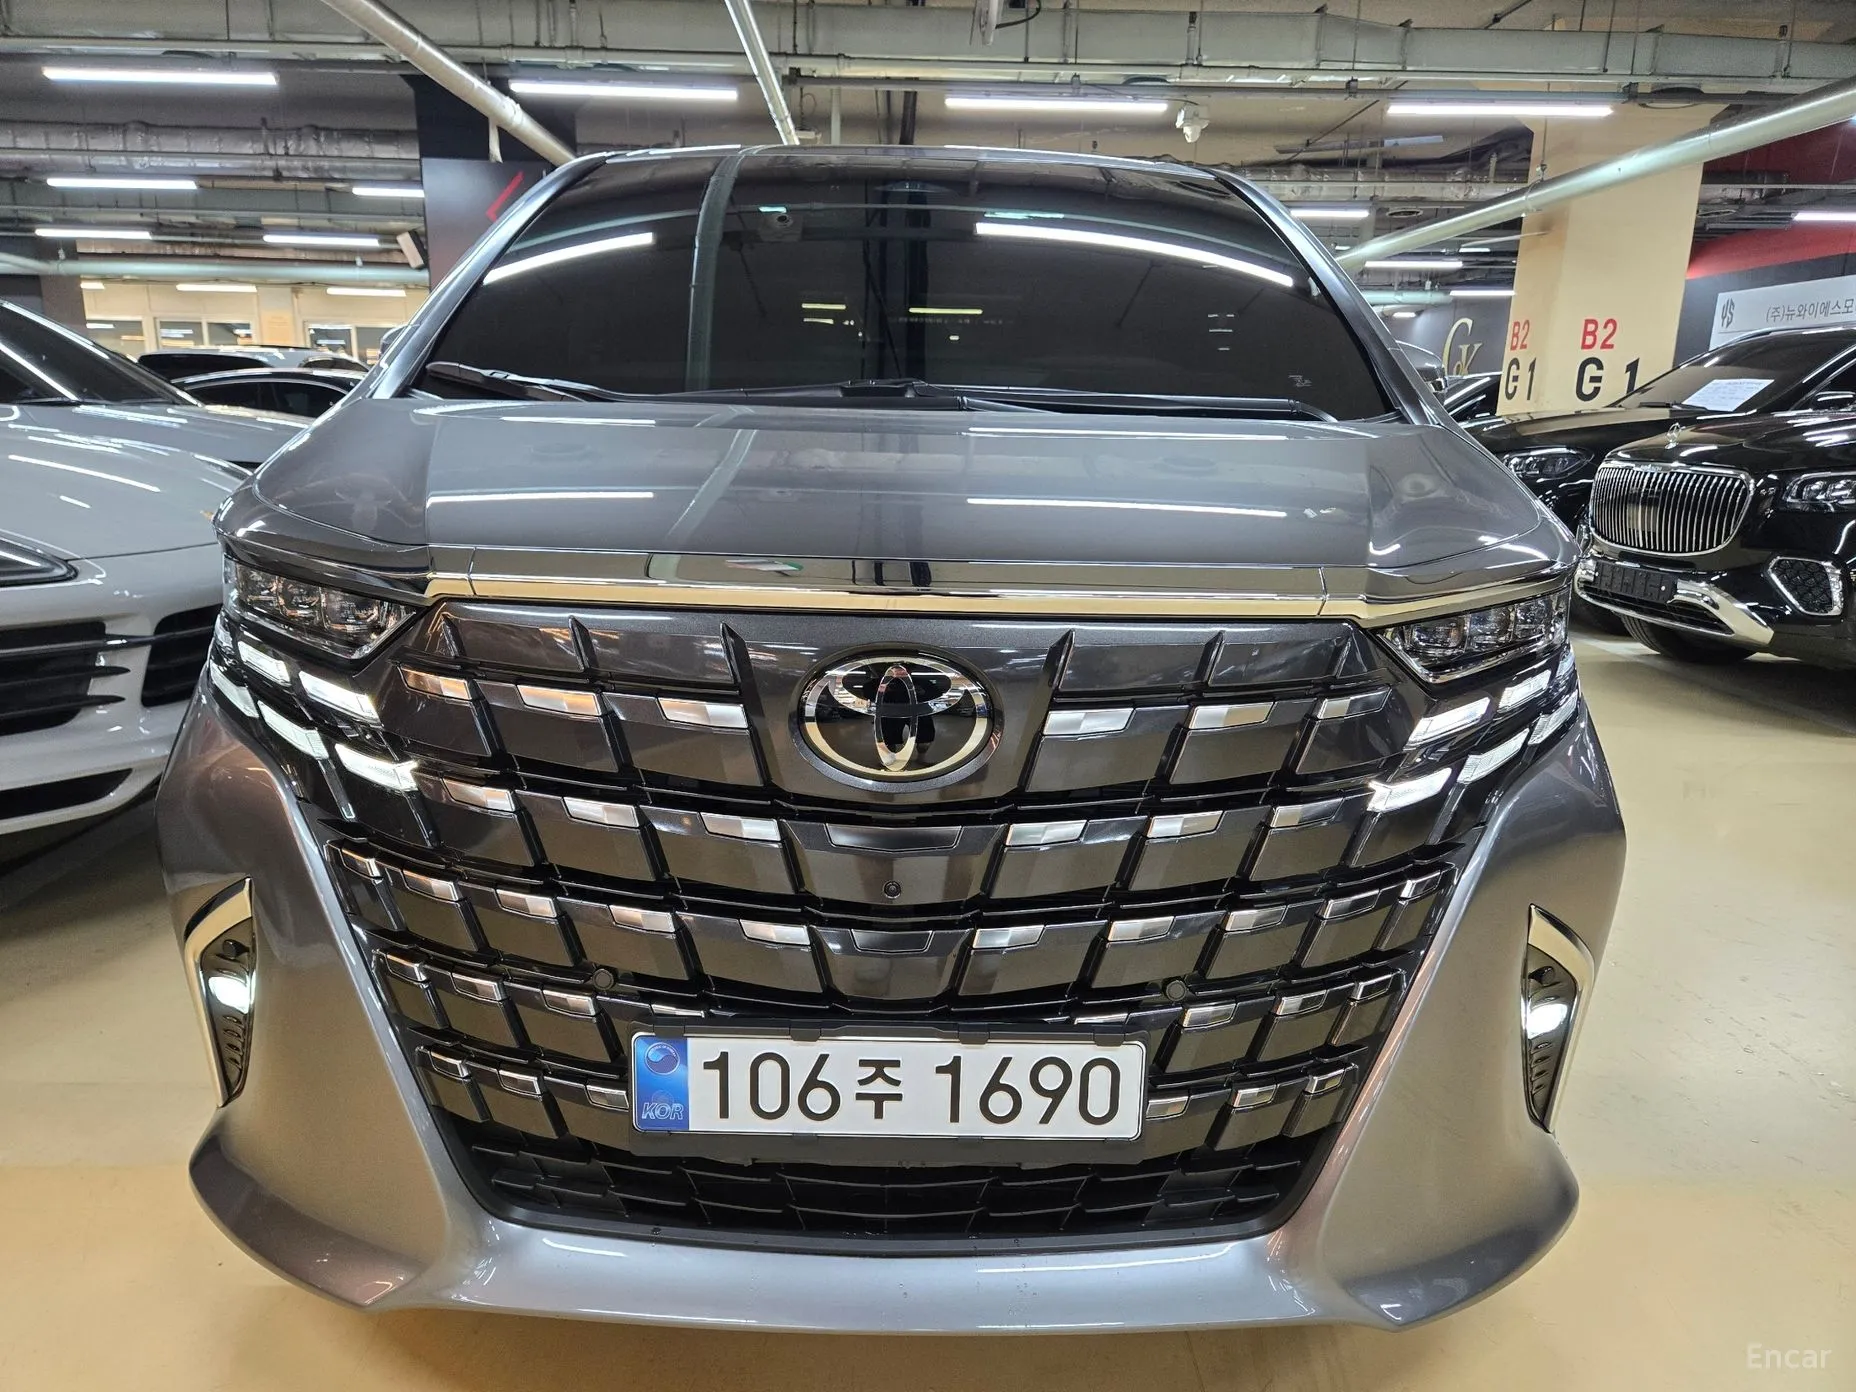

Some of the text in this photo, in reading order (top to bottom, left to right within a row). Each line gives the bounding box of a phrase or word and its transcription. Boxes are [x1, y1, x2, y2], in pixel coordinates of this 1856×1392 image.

[1510, 319, 1531, 351] B2
[1581, 318, 1618, 350] B2
[1575, 356, 1641, 402] G 1
[703, 1051, 1121, 1126] 106주 1690
[641, 1102, 685, 1120] KOR
